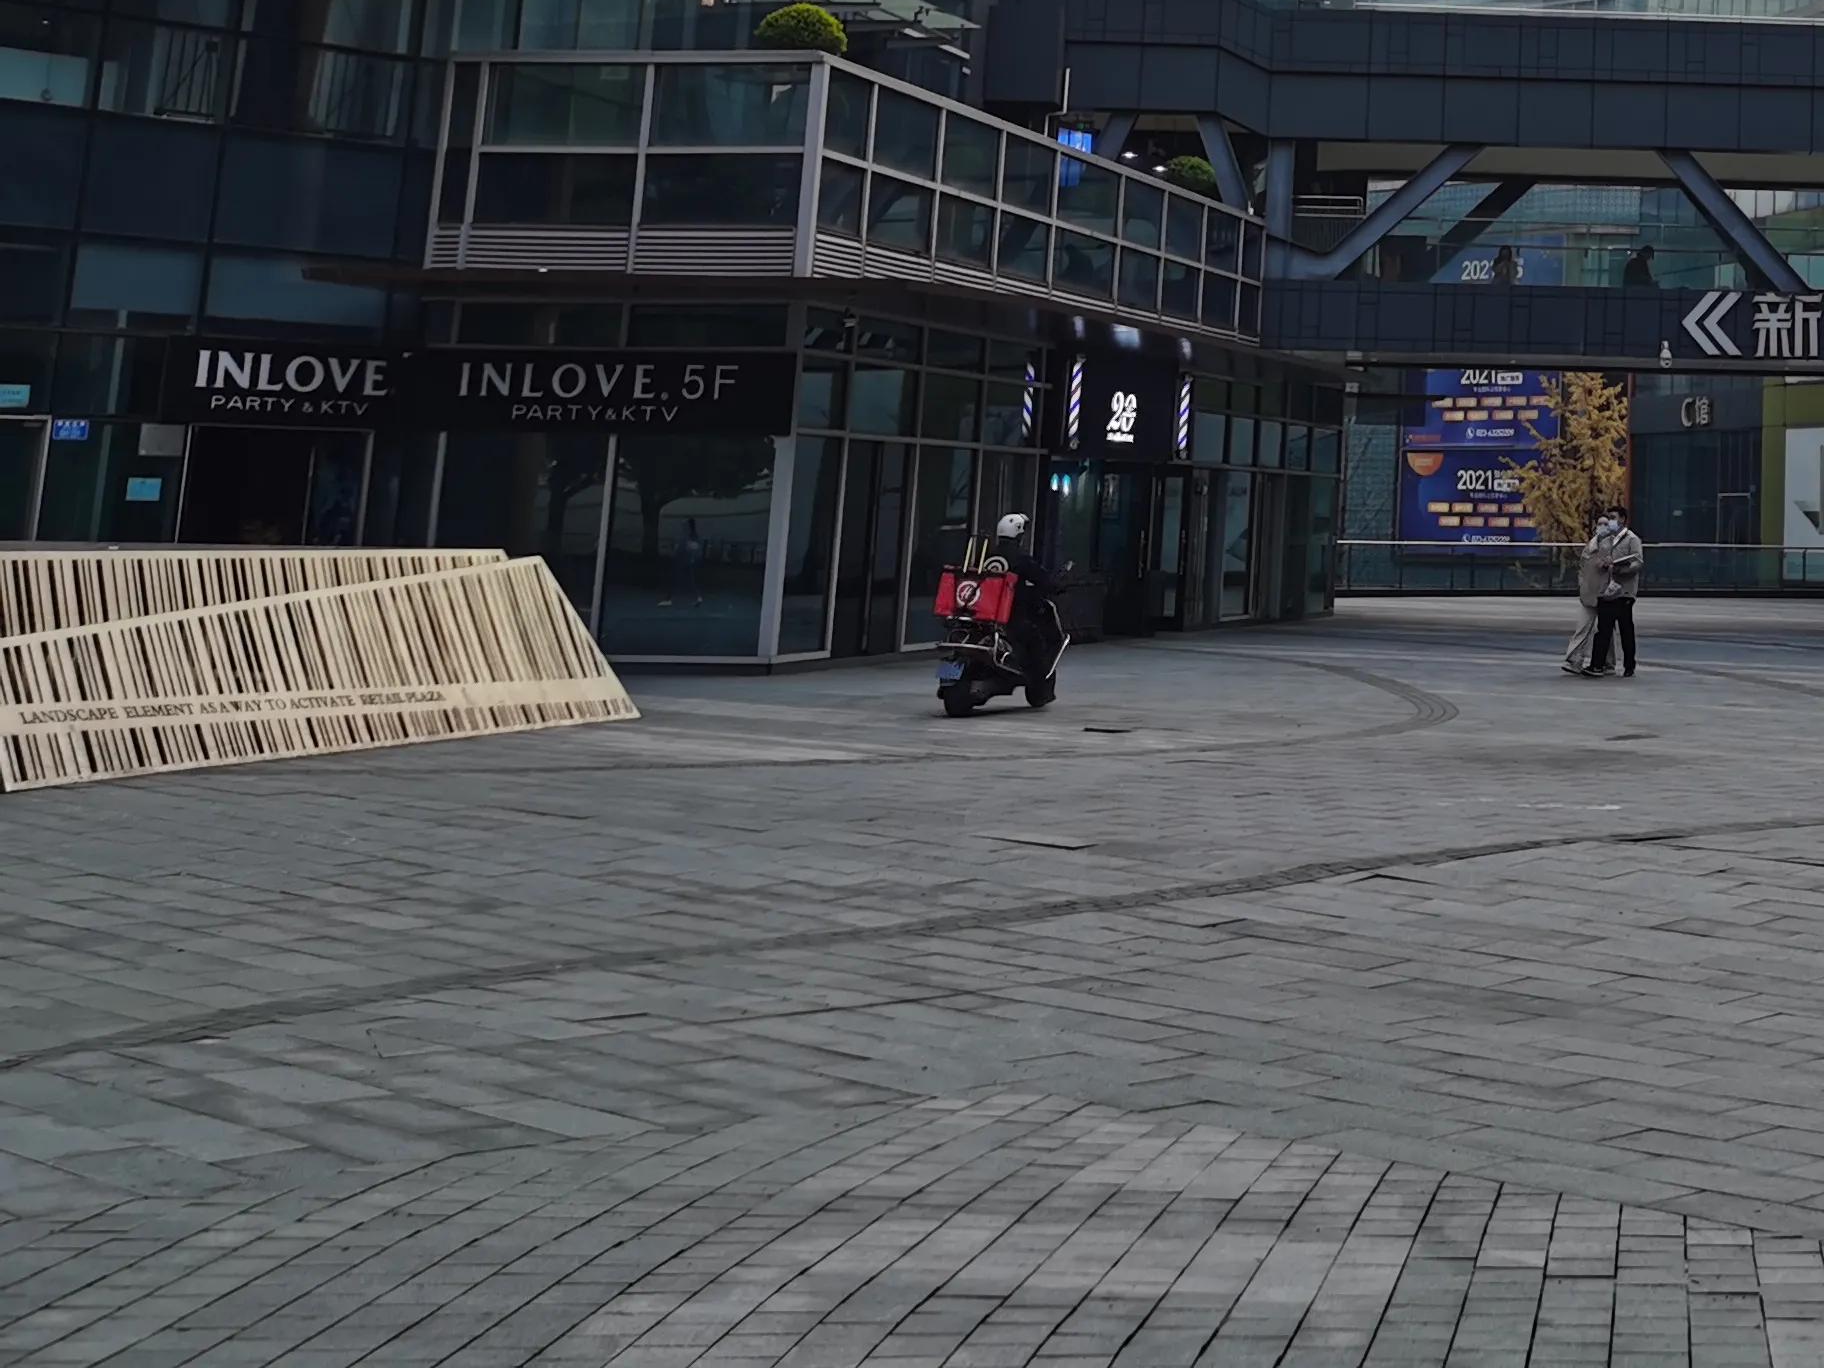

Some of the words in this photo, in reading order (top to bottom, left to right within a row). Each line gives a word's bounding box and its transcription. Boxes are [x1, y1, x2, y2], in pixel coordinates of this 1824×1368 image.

[210, 395, 295, 413] PARTY
[319, 400, 368, 415] KTV
[1457, 469, 1493, 491] 2021
[19, 707, 120, 725] LANDSCAPE
[124, 702, 195, 719] ELEMENT
[200, 701, 217, 714] AS
[230, 699, 262, 712] WAY
[263, 697, 286, 712] TO
[290, 694, 356, 710] ACTIVATE
[360, 692, 405, 705] RETAIL
[406, 690, 446, 703] PLAZA
